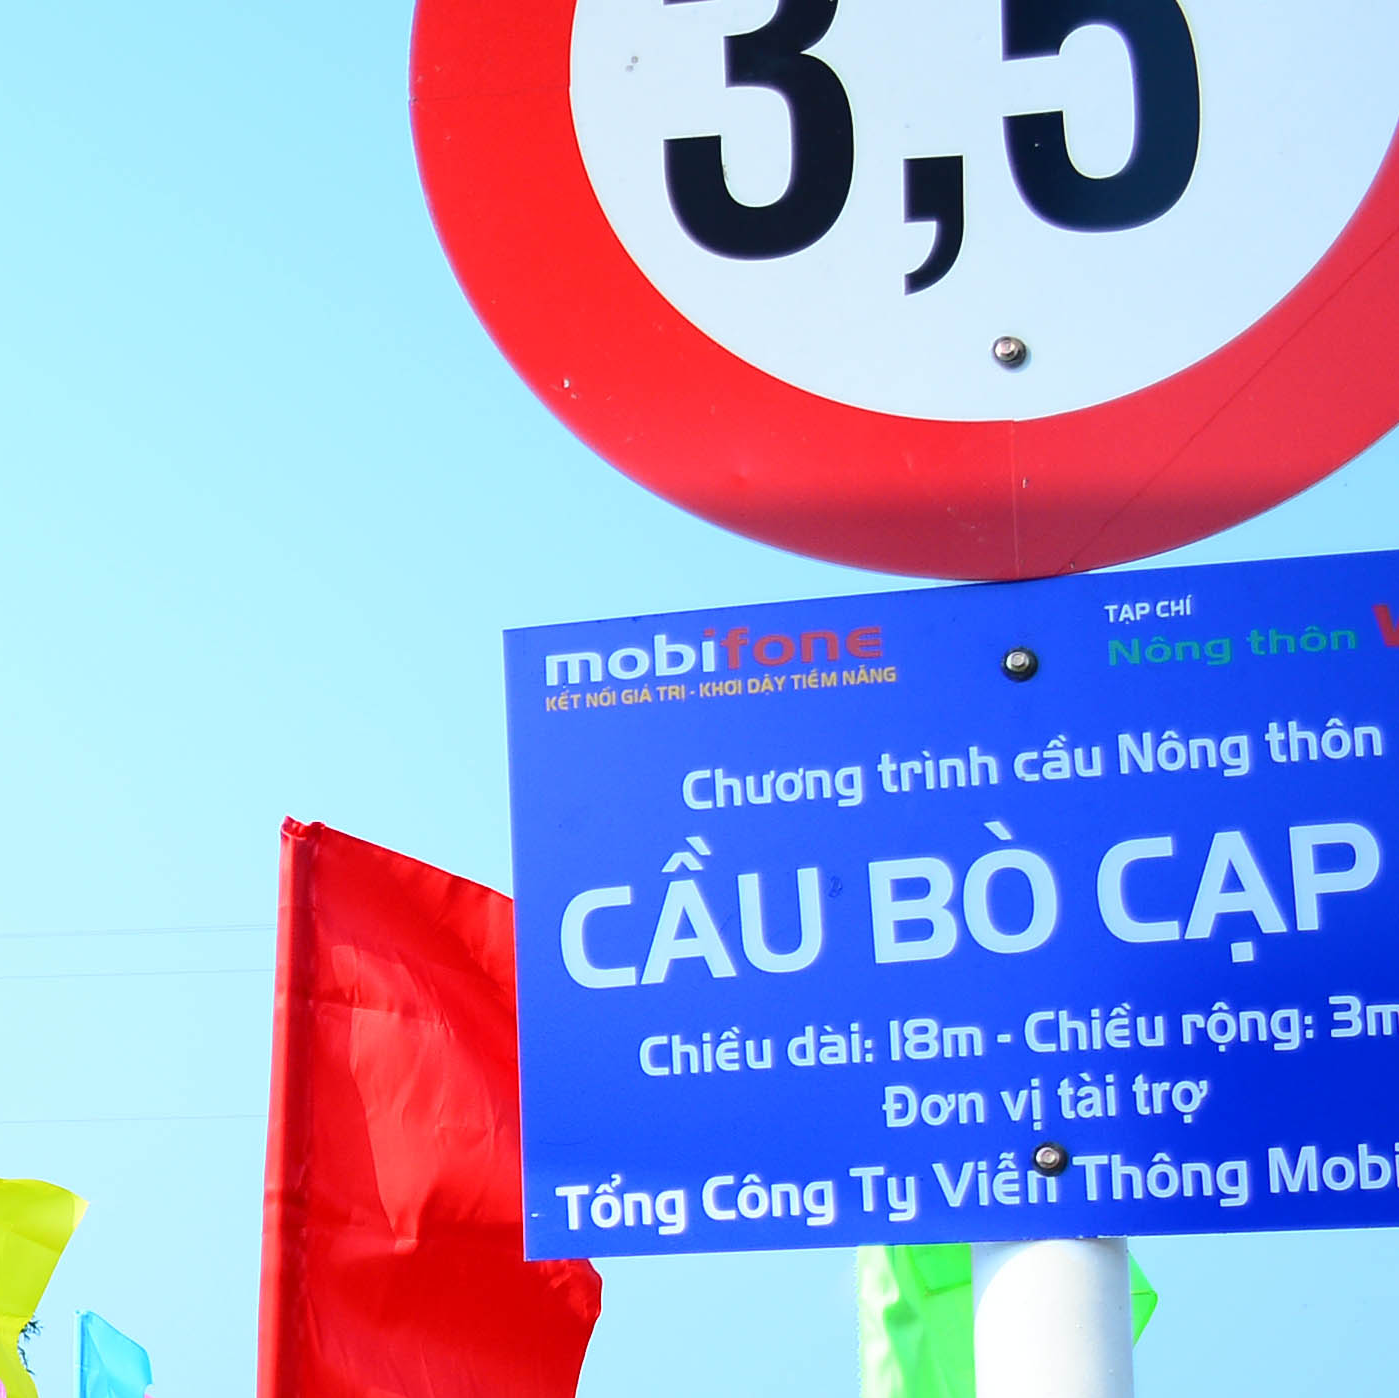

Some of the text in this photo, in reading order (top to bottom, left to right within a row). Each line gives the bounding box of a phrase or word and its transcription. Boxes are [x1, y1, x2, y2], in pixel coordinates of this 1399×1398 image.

[662, 0, 1201, 296] 3,5
[1104, 594, 1193, 624] TẠP CHÍ
[1107, 635, 1232, 666] Nông
[1247, 624, 1357, 656] thôn
[545, 625, 883, 687] mobifone
[682, 717, 1384, 811] Chương trình cầu Nông thôn
[558, 820, 1381, 991] CẦU BÒ CẠP
[639, 1026, 773, 1077] Chiều
[786, 1022, 875, 1068] dài:
[1024, 1002, 1165, 1053] Chiều
[1181, 1000, 1315, 1054] rộng:
[882, 1072, 1209, 1131] Đơn vị tài trợ
[555, 1173, 687, 1236] Tổng
[701, 1173, 837, 1228] Công
[848, 1166, 917, 1223] Ty
[932, 1151, 1059, 1209] Viễn
[1072, 1151, 1251, 1208] Thông
